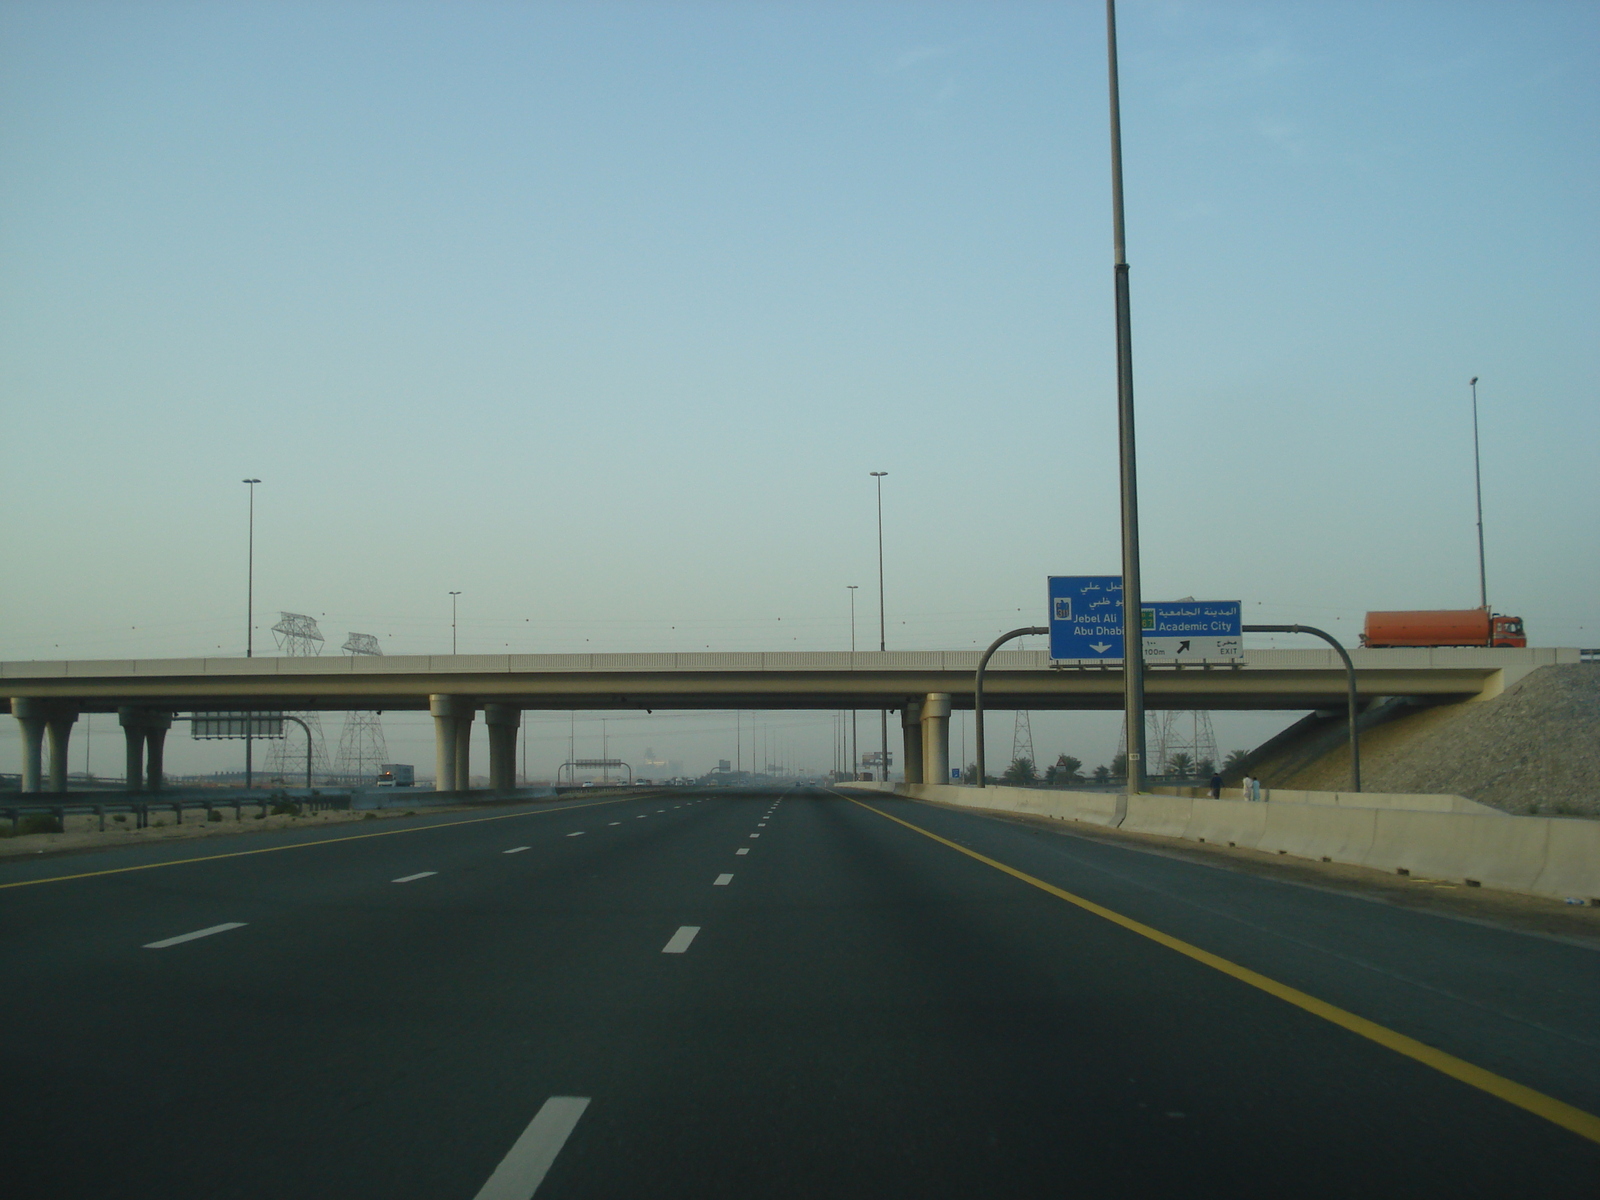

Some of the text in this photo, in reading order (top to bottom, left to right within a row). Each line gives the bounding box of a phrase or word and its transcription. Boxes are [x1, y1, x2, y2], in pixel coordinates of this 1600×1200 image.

[1080, 582, 1100, 595] علي
[1089, 597, 1111, 611] ظبي
[1159, 607, 1236, 618] المدينة الجامعية
[1074, 614, 1117, 623] Jebel Ali
[1074, 627, 1125, 636] Abu Dhabi
[1159, 621, 1231, 632] Academic City
